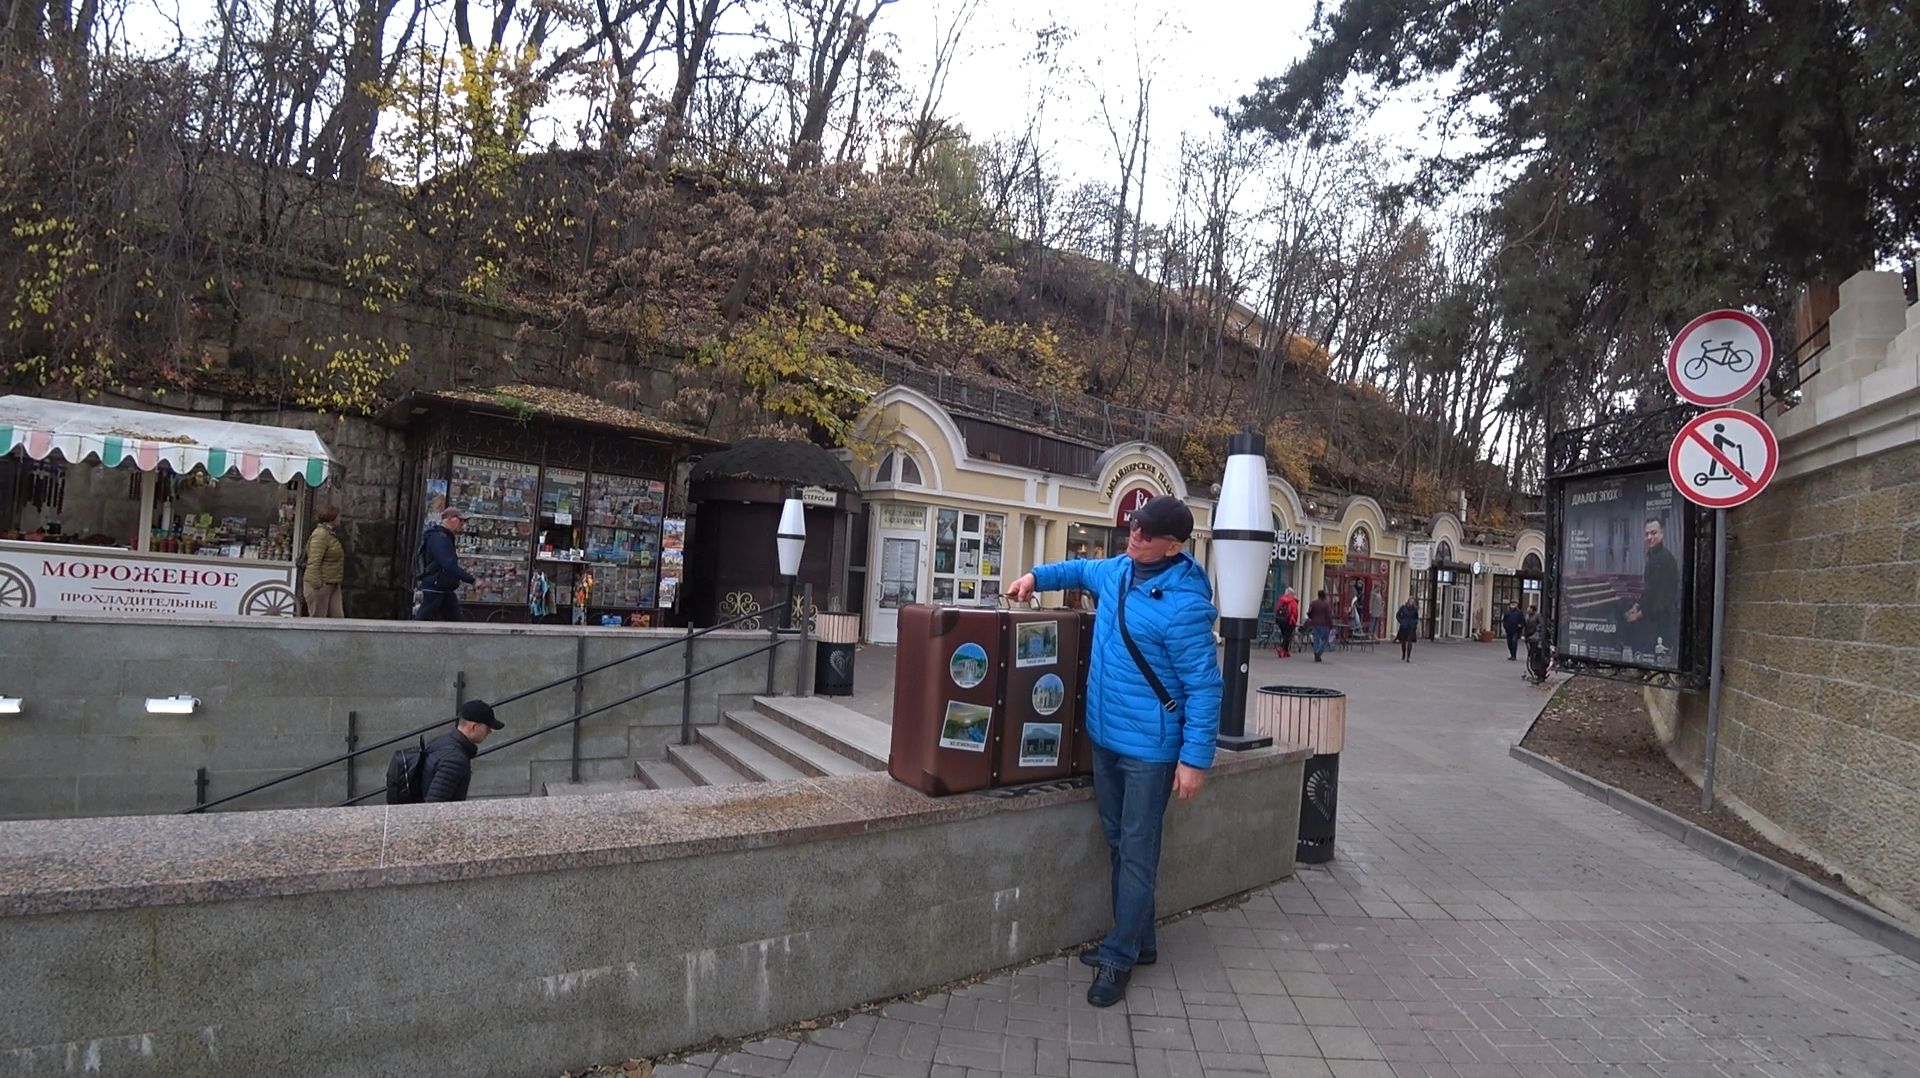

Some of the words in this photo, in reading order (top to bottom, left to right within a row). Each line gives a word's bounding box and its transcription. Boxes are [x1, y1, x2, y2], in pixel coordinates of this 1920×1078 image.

[803, 494, 833, 503] СТЕРСКАЯ
[42, 560, 239, 587] МОРОЖЕНОЕ
[60, 593, 218, 609] ПРОХЛАДИТЕЛЬНЫЕ
